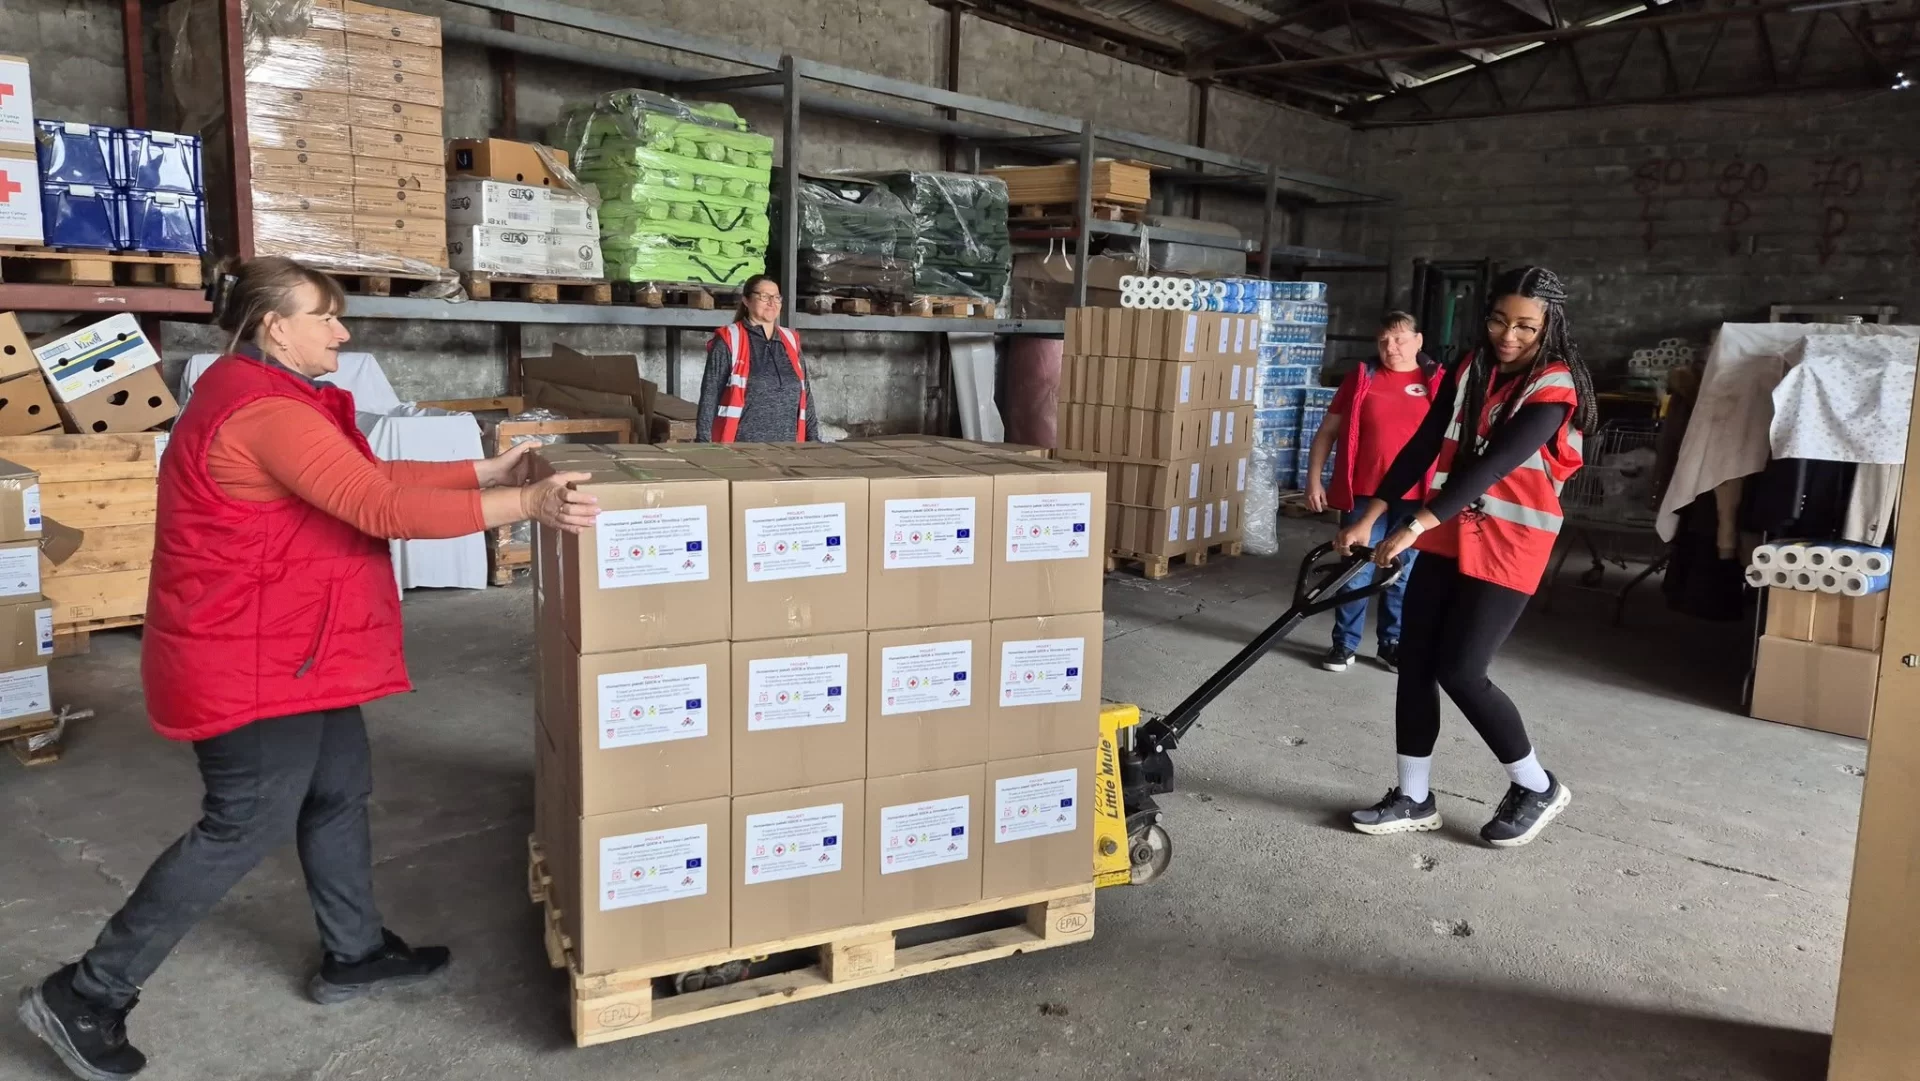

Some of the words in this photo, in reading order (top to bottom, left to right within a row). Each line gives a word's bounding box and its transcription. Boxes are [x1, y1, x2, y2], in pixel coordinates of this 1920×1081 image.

[1100, 740, 1114, 776] Mule
[1104, 780, 1119, 819] Little
[1060, 916, 1083, 930] EPAL
[603, 1008, 635, 1023] EPAL
